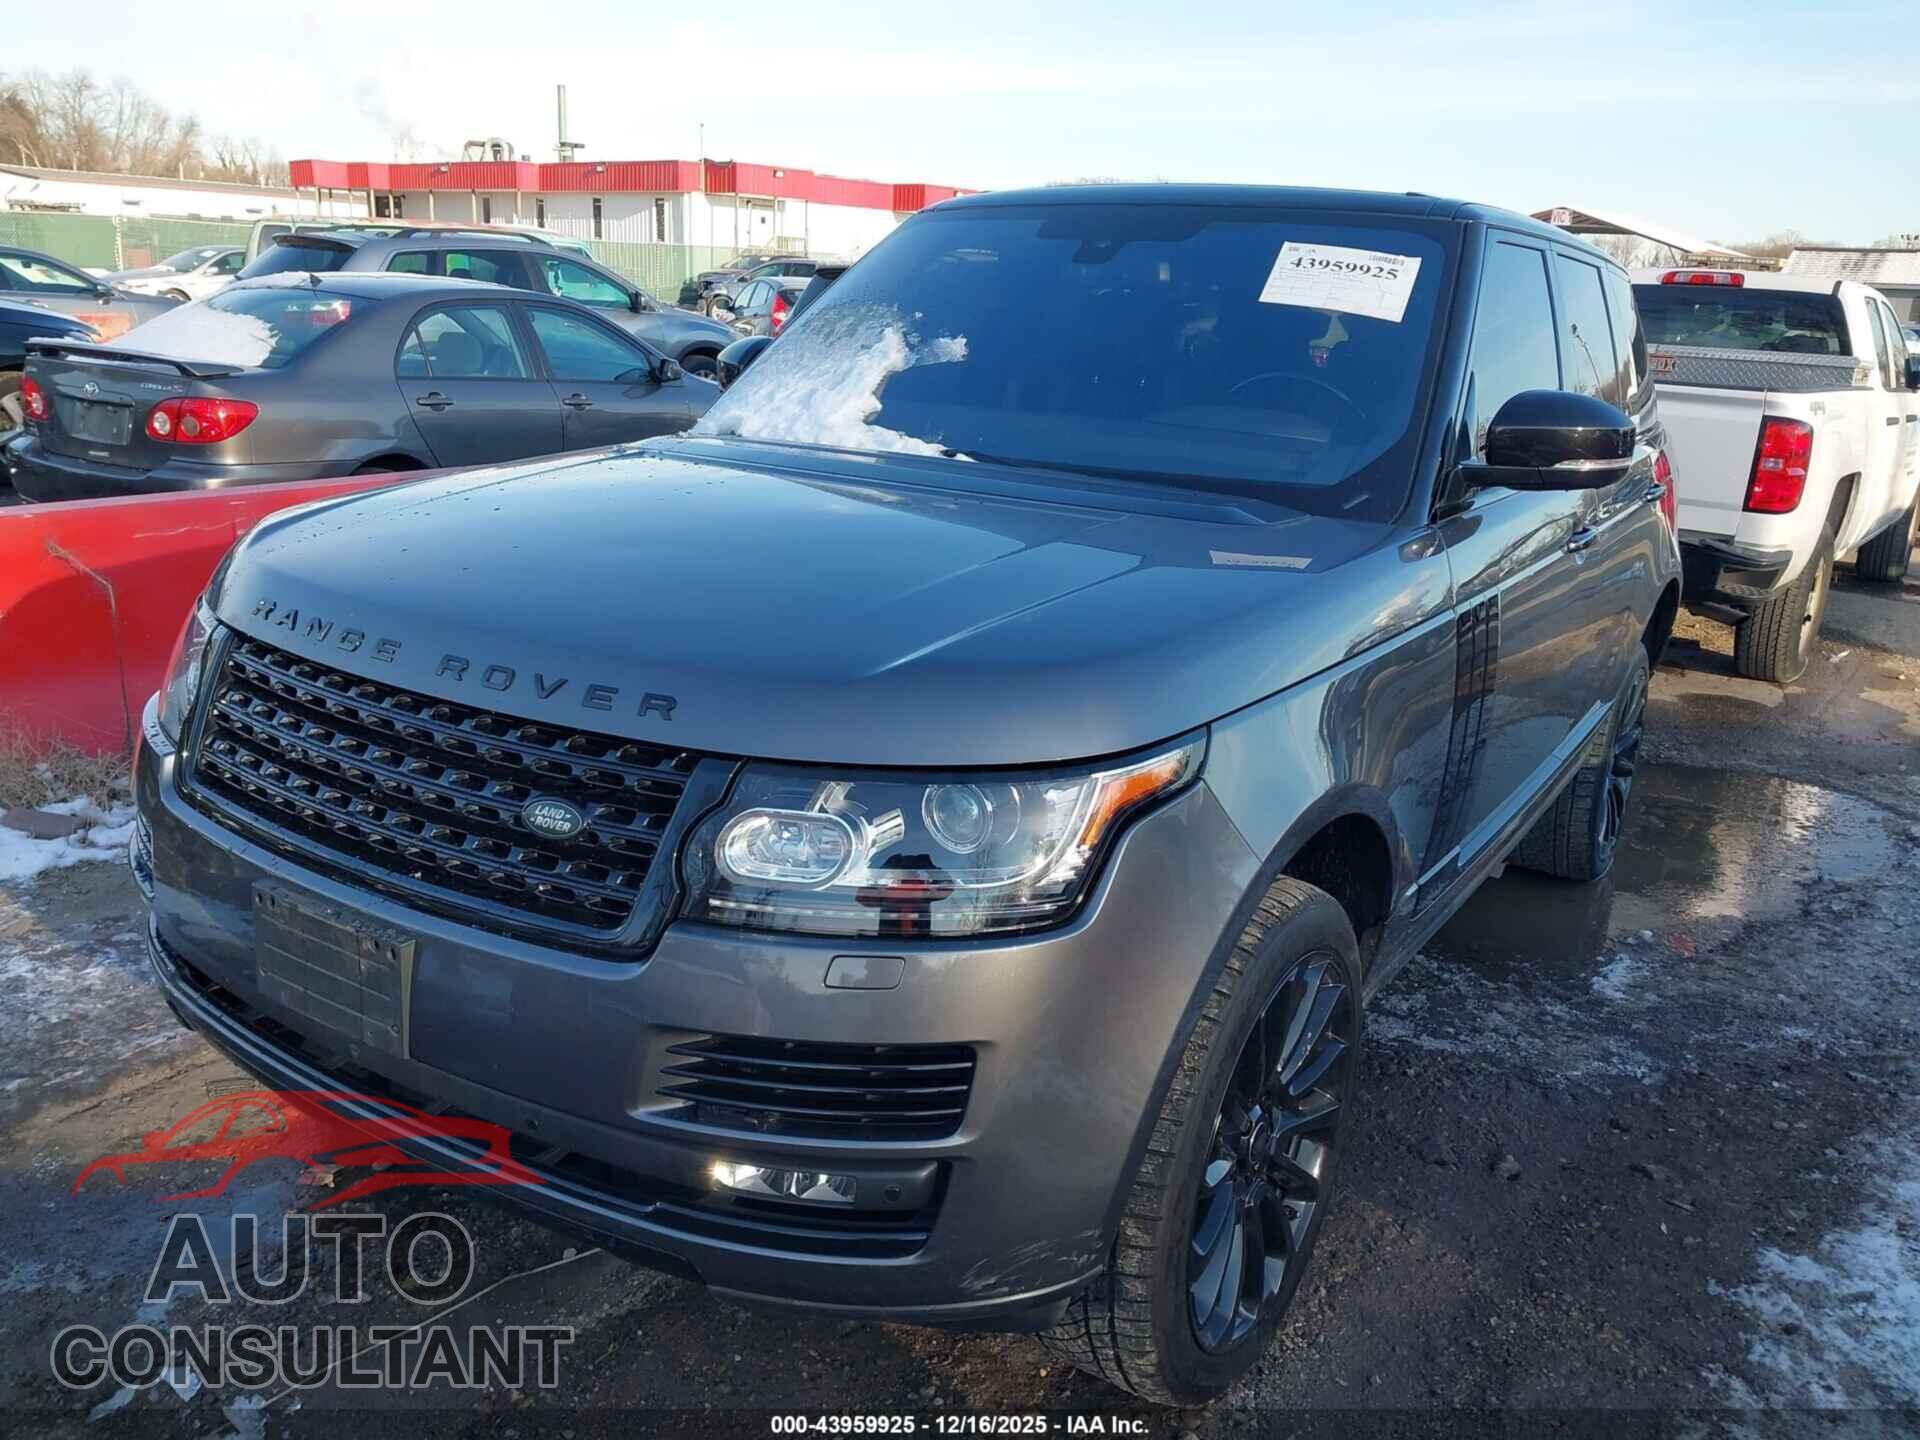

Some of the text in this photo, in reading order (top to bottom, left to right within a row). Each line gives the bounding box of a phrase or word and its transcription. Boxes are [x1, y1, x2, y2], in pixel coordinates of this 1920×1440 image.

[1290, 256, 1399, 281] 43959925
[251, 597, 678, 722] RANGE ROVER
[535, 804, 565, 820] LAND
[534, 815, 571, 833] ROVER
